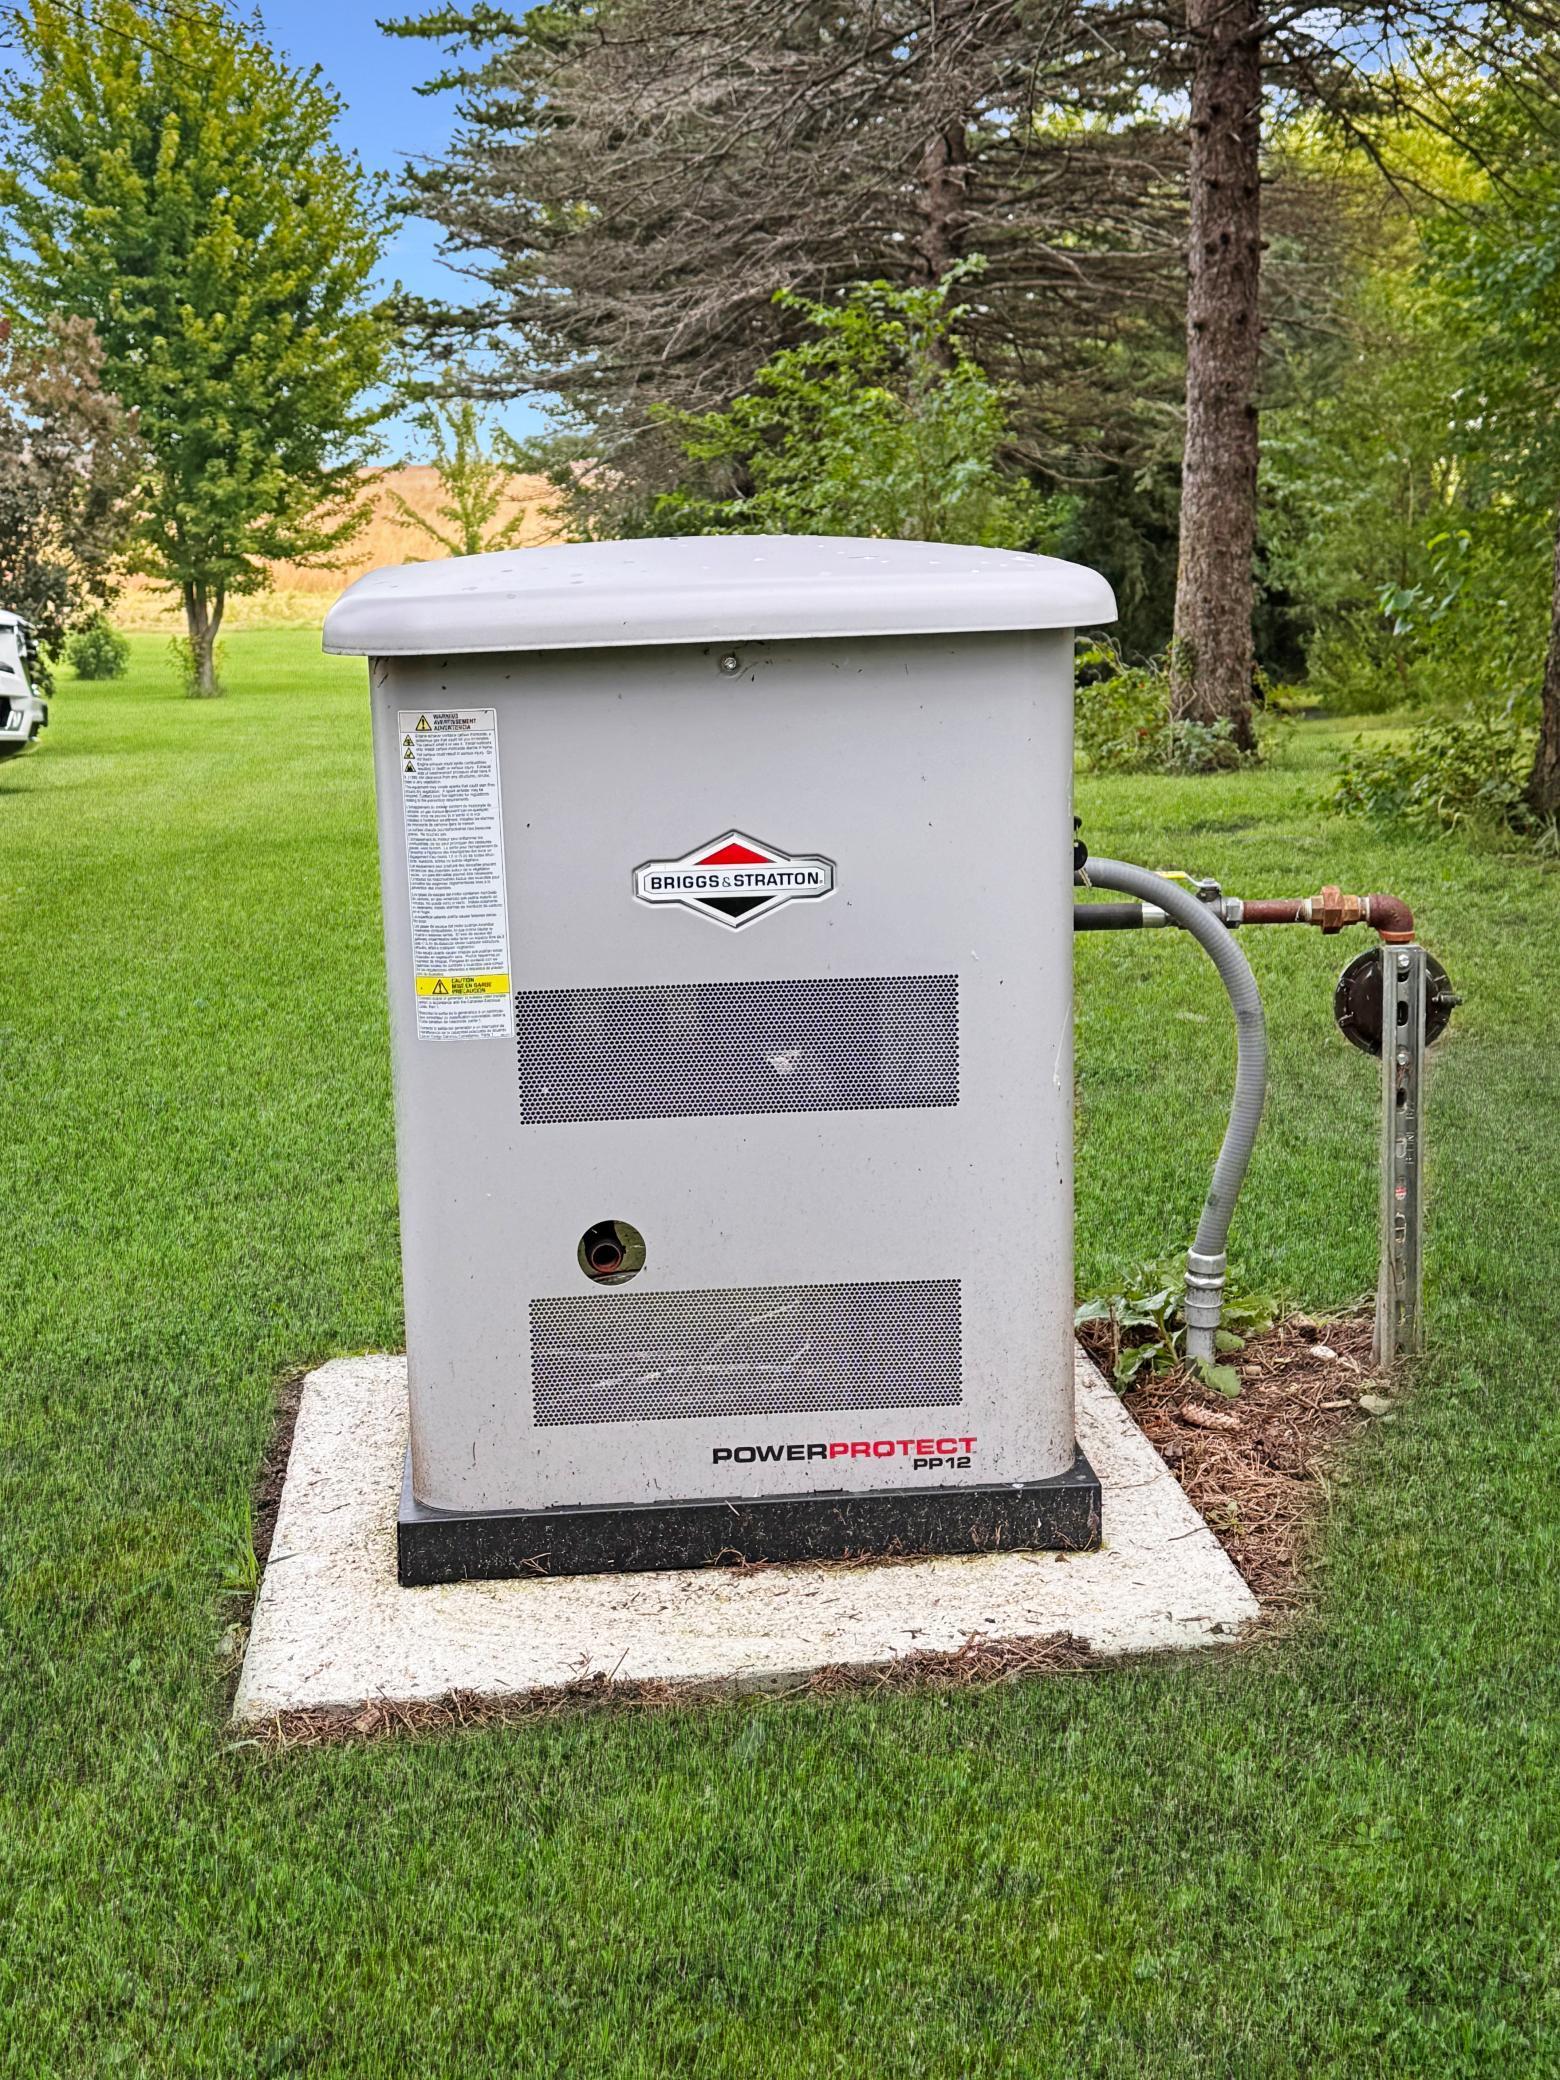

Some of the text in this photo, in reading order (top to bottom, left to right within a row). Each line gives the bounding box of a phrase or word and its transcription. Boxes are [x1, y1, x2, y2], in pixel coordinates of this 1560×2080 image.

[651, 874, 720, 890] BRIGGS
[733, 871, 819, 887] STRATTON
[712, 1437, 977, 1464] POWERPROTECT
[913, 1456, 971, 1471] PP12
